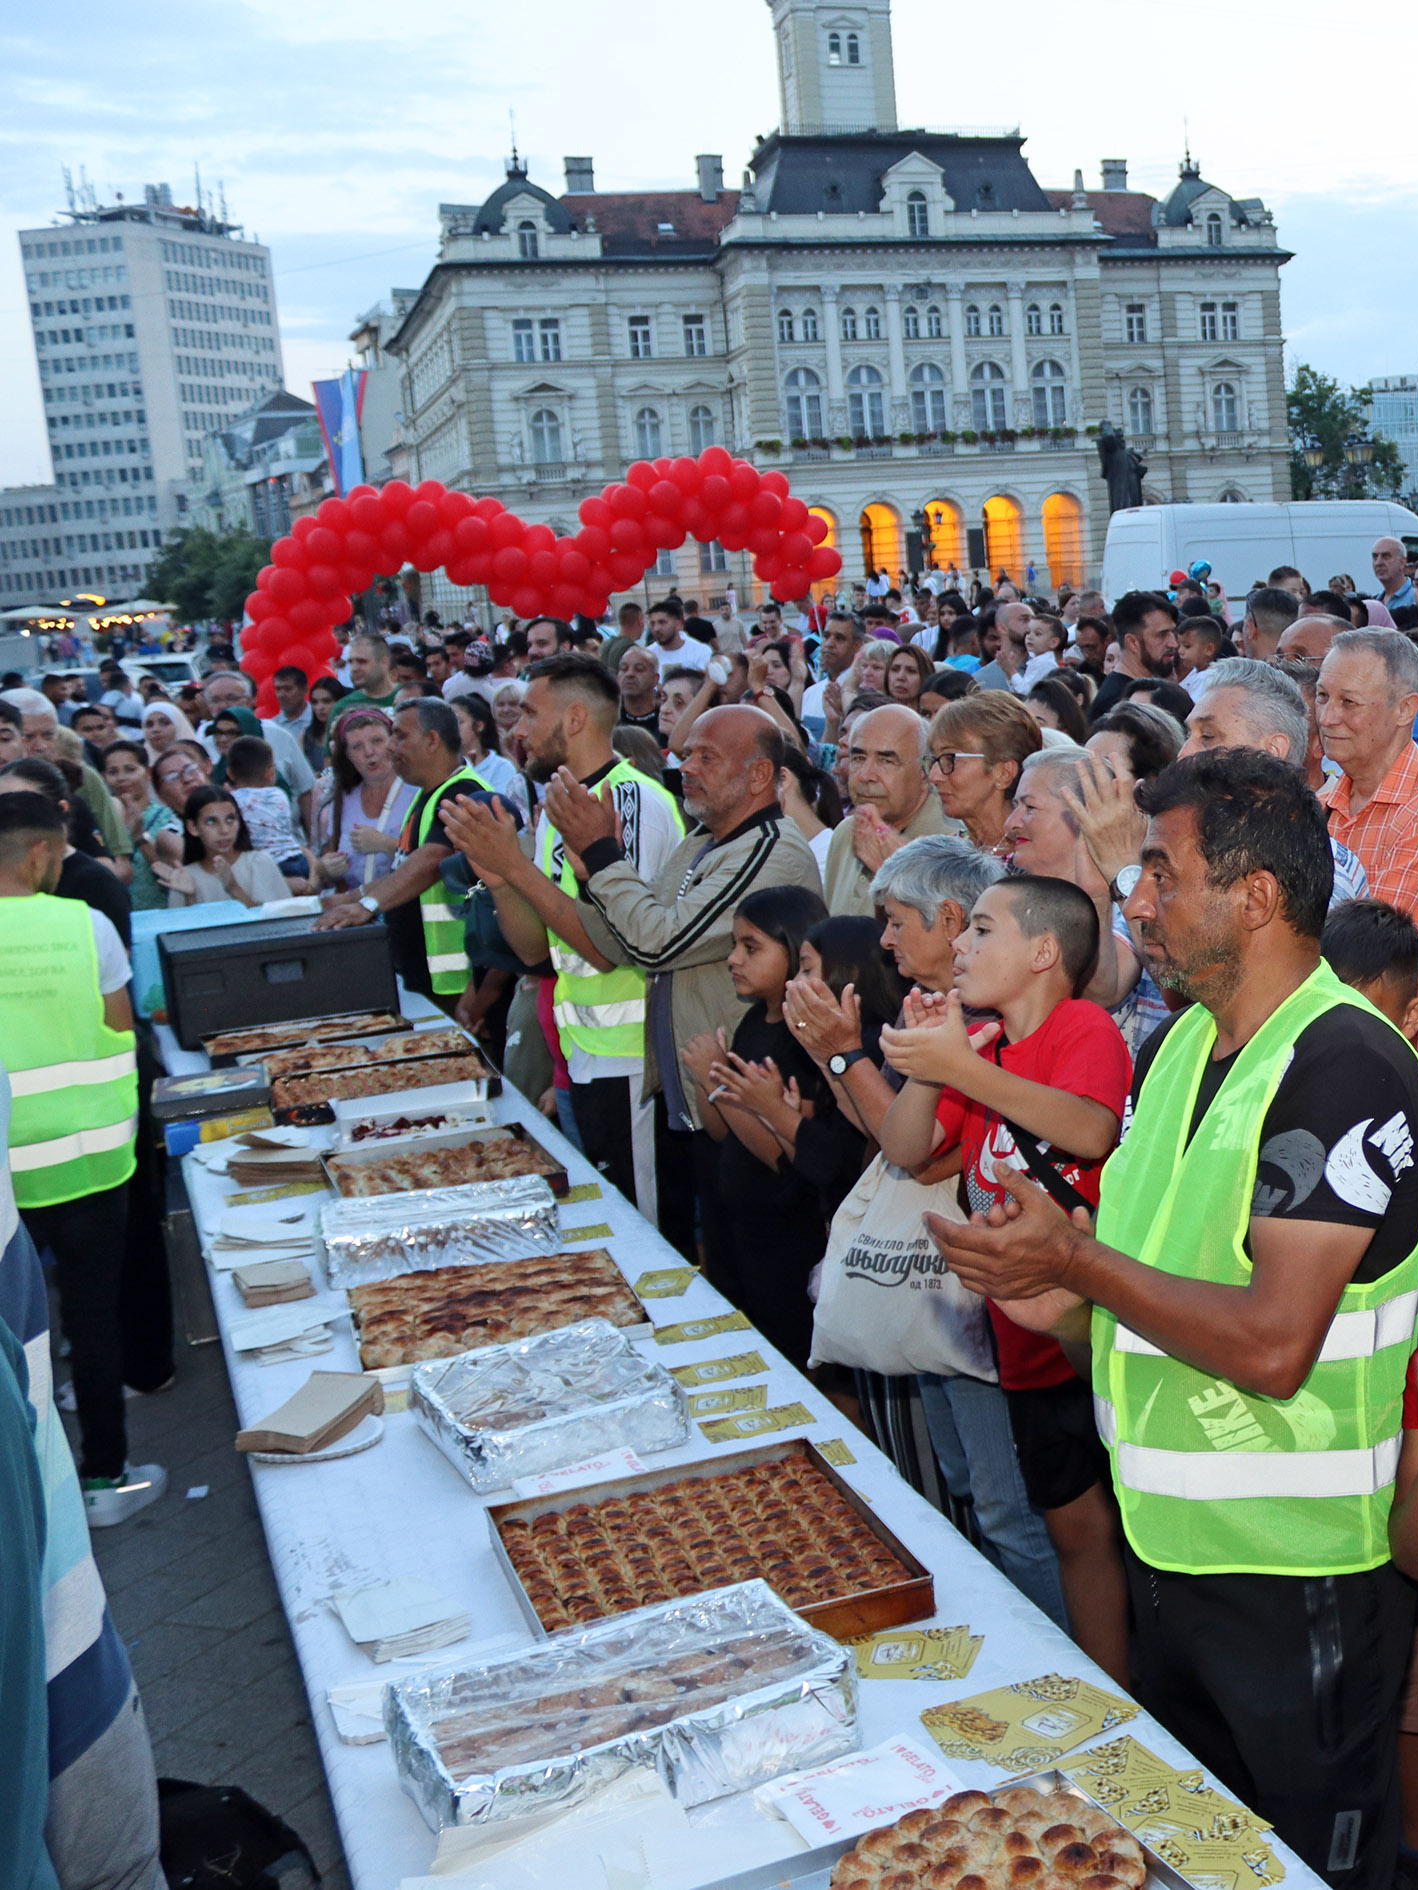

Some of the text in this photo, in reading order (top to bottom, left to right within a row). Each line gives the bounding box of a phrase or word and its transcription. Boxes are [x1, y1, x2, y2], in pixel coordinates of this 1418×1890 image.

[857, 1233, 904, 1251] СВИЈЕТЛО
[909, 1278, 944, 1290] од 1873.
